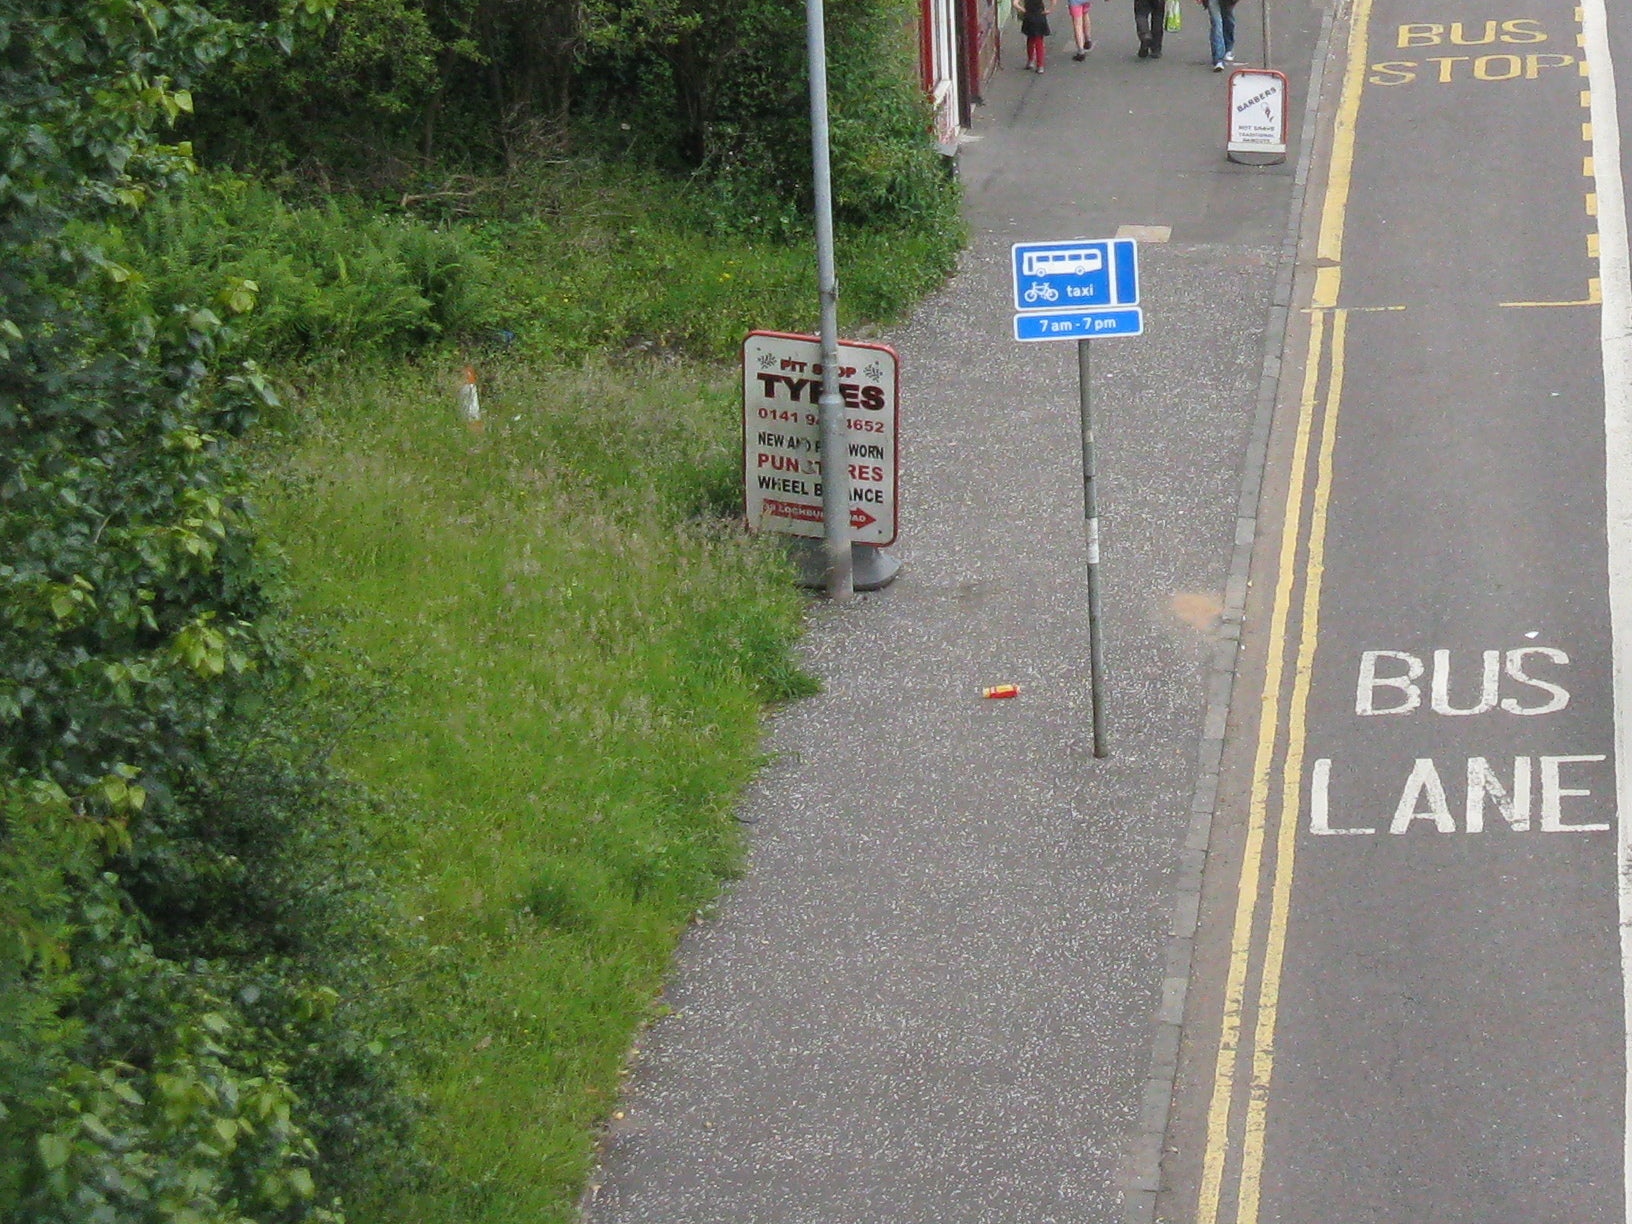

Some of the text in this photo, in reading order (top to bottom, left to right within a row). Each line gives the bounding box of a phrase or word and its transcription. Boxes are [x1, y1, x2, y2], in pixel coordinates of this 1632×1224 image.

[1397, 19, 1548, 49] BUS
[1369, 54, 1576, 86] STOP
[1237, 87, 1277, 112] BARBERS
[1066, 284, 1094, 297] taxi
[781, 357, 857, 378] PIT SOP
[758, 408, 799, 423] 0141
[758, 431, 784, 448] NEW
[849, 443, 884, 460] WORN
[758, 475, 809, 496] WHEEL
[1355, 646, 1571, 716] BUS
[1309, 754, 1610, 835] LANE
